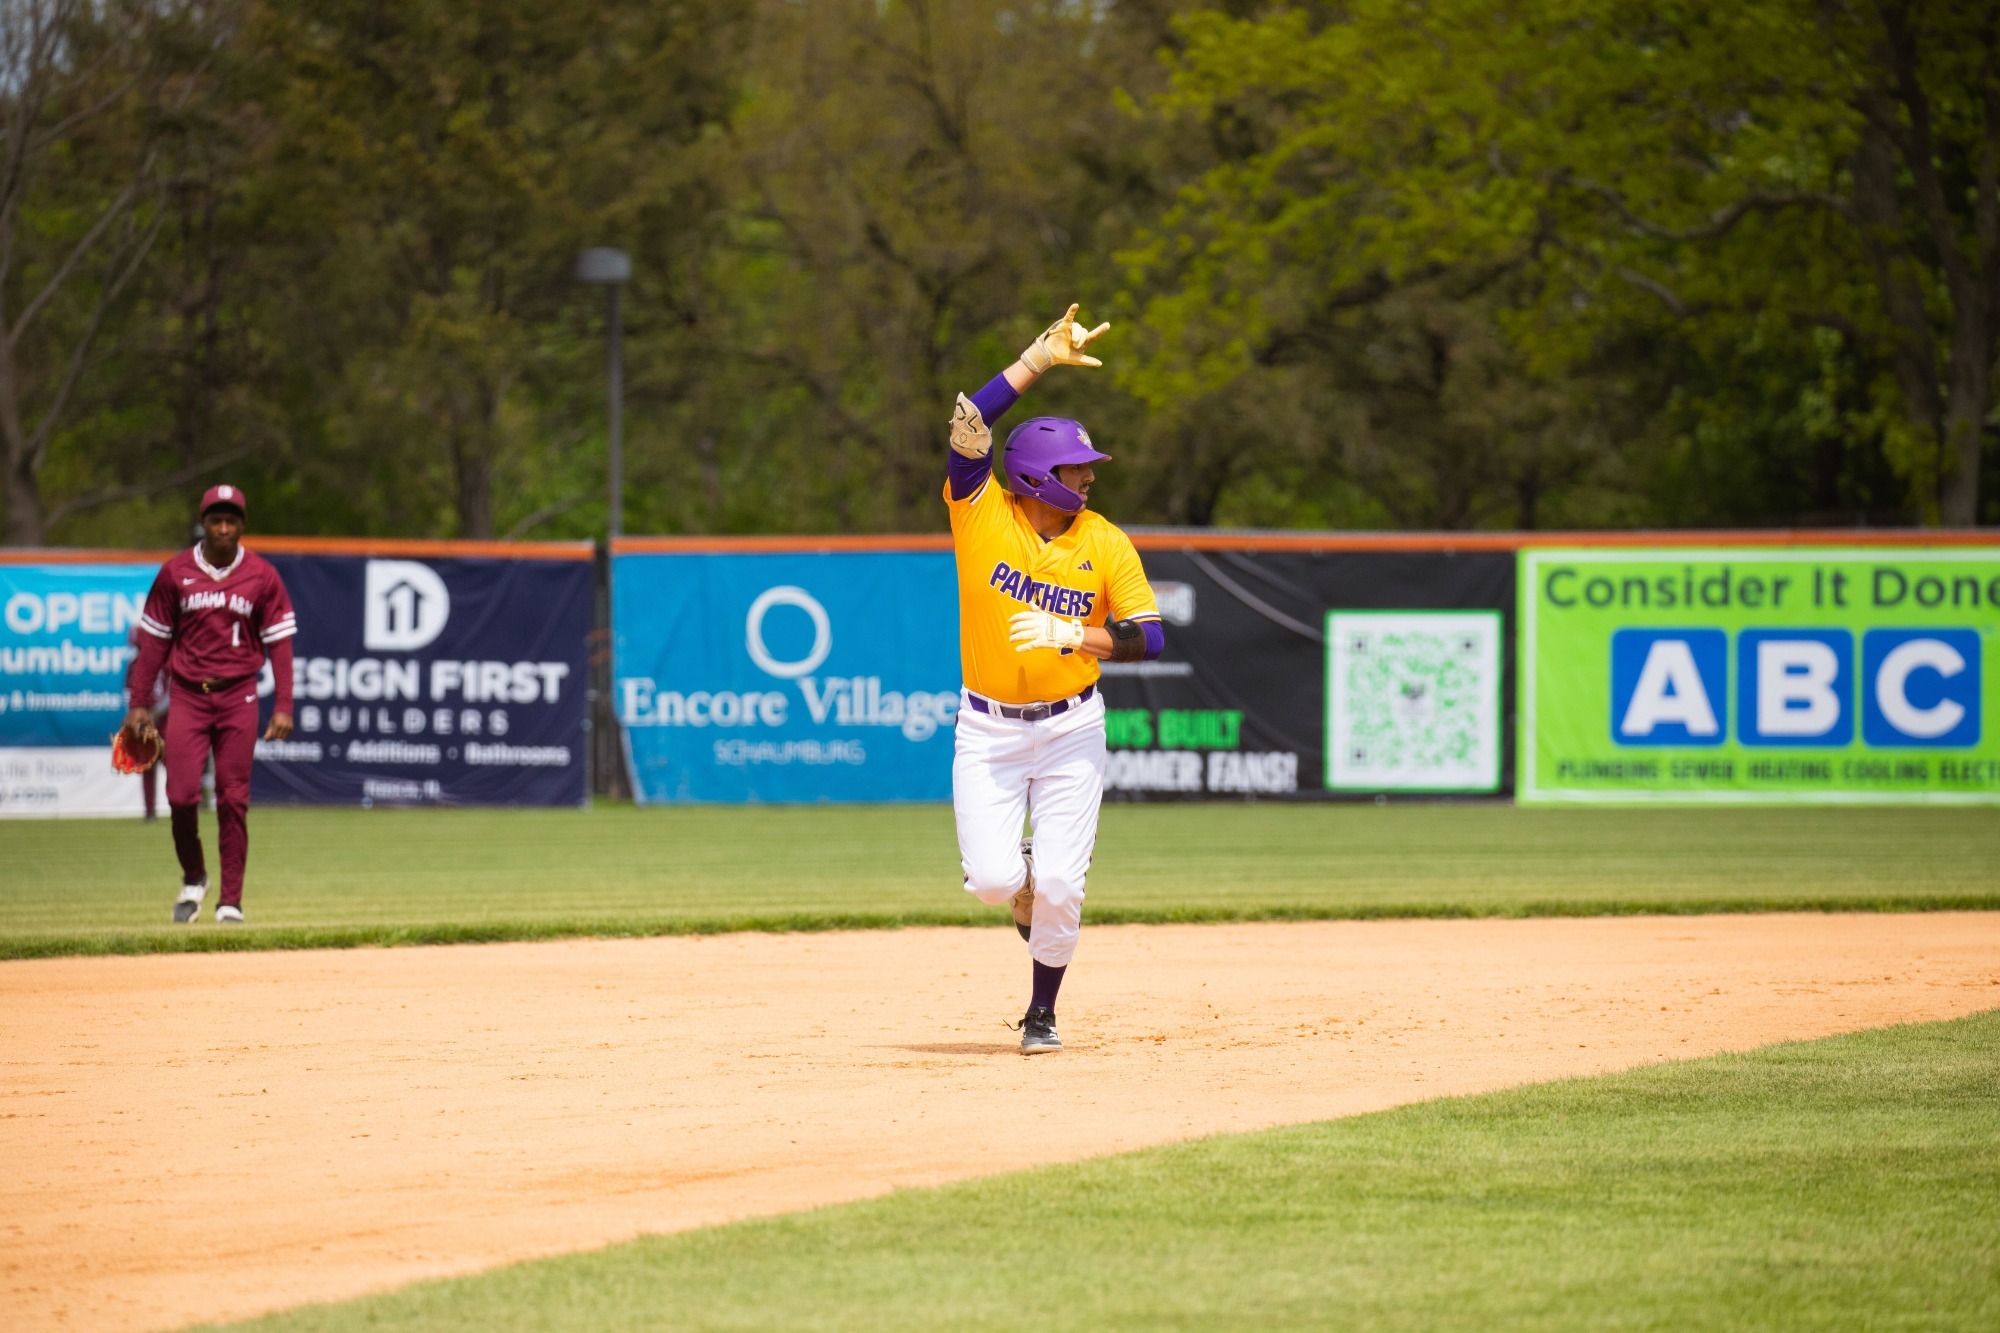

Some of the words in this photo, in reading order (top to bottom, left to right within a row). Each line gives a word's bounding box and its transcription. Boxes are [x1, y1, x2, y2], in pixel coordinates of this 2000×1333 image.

[988, 561, 1096, 618] PANTHERS
[1545, 567, 1790, 610] Consider
[1813, 567, 1849, 609] It
[5, 592, 147, 634] OPEN
[232, 621, 241, 647] 1
[0, 640, 139, 675] umbur
[430, 660, 569, 703] FIRST
[301, 706, 509, 736] BUILDERS
[618, 677, 789, 727] Encore
[796, 676, 957, 741] Village
[1158, 708, 1244, 750] BUILT
[1206, 752, 1298, 792] FANS!
[1939, 758, 2000, 784] ELECT
